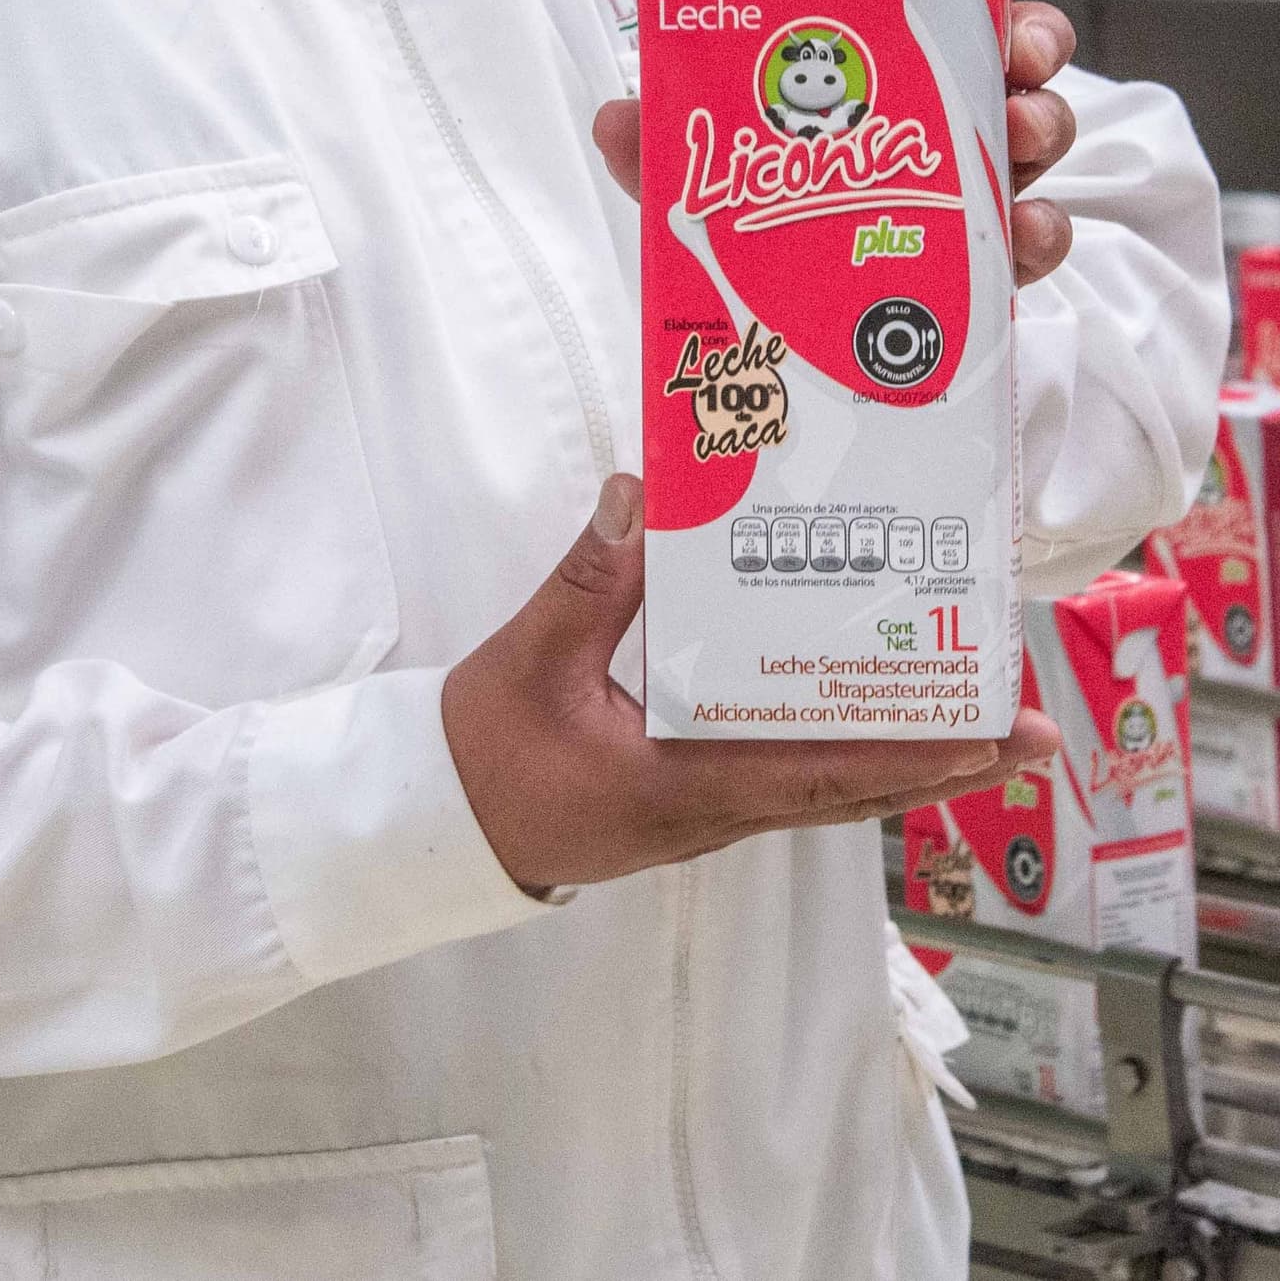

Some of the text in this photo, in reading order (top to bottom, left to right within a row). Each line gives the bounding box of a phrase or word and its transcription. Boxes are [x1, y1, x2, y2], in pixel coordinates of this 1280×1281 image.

[684, 108, 942, 220] Liconsa
[853, 216, 924, 266] plus
[885, 304, 911, 315] SELLO
[666, 320, 787, 395] Leche
[698, 382, 781, 413] 100%
[734, 410, 753, 422] de
[695, 418, 787, 460] vaca
[752, 503, 898, 516] Una porción de 240 ml aporta:
[750, 577, 763, 587] de
[765, 577, 778, 587] los
[781, 578, 841, 587] nutrimentos
[843, 577, 875, 587] diarios
[915, 586, 931, 597] por
[928, 576, 976, 588] porciones
[877, 619, 917, 635] Cont.
[928, 605, 978, 652] 1L
[887, 637, 917, 651] Net.
[761, 655, 979, 675] Leche Semidescremada
[819, 680, 979, 702] Ultrapasteurizada
[693, 702, 979, 727] Adicionada con Vitaminas A y D
